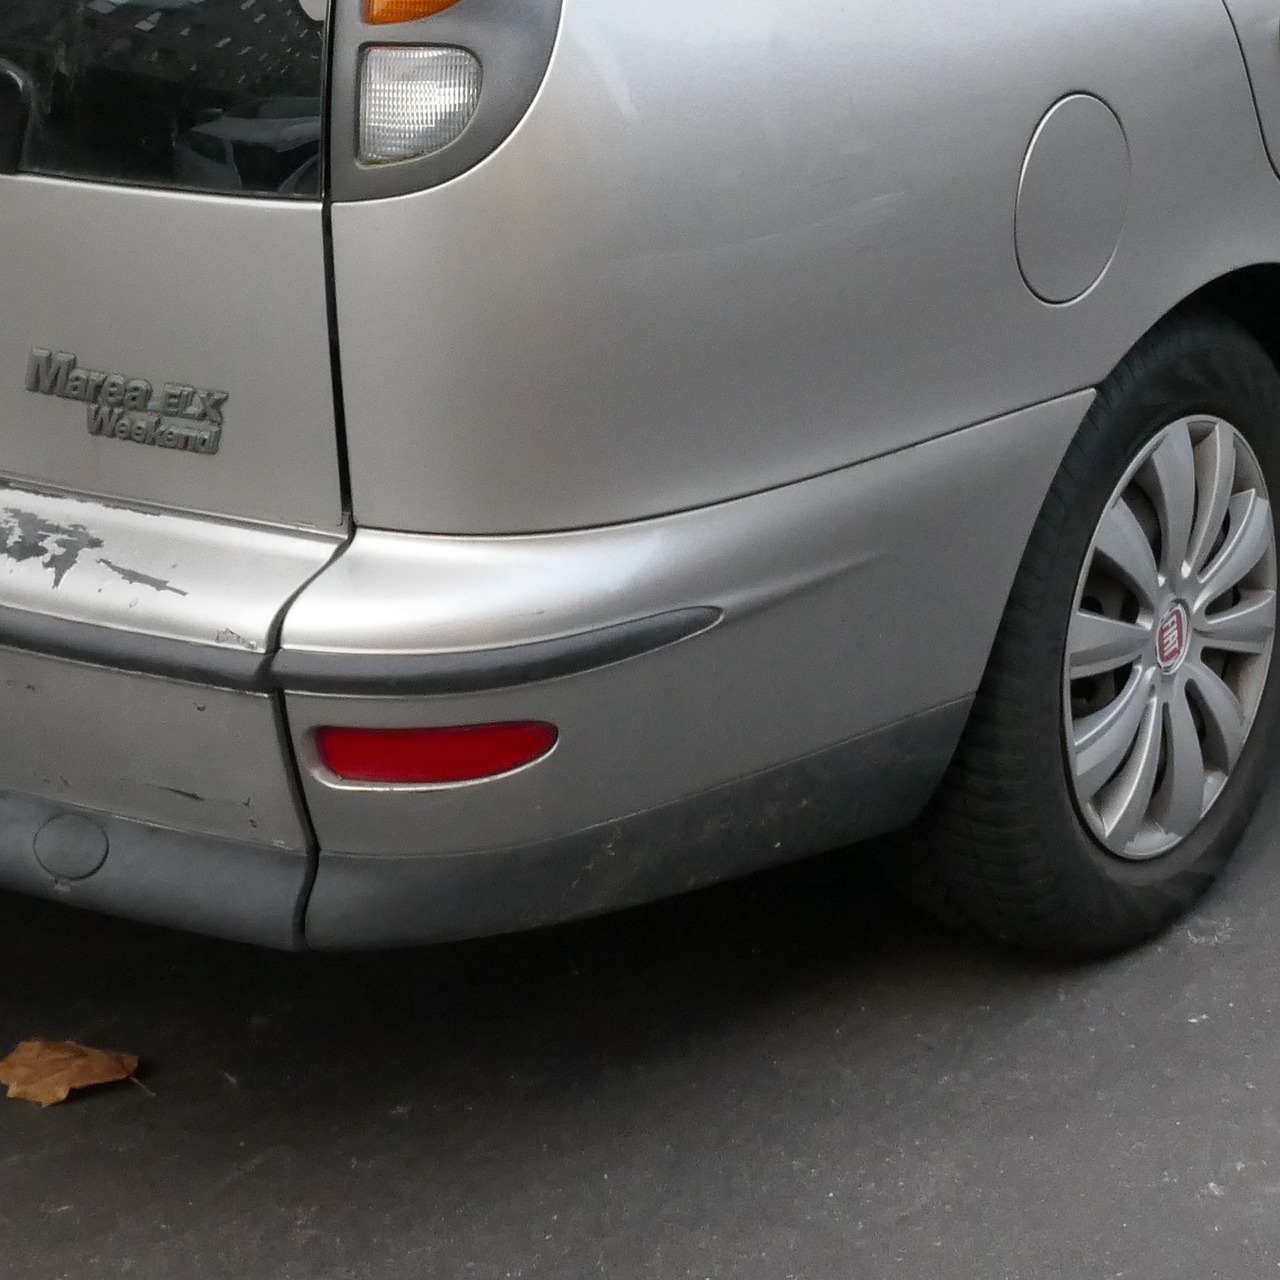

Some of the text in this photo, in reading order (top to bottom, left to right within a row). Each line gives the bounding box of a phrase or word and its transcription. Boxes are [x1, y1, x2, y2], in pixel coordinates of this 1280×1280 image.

[25, 347, 229, 424] Marea ELX
[87, 403, 222, 454] Weekend
[1162, 614, 1180, 657] FIAT
